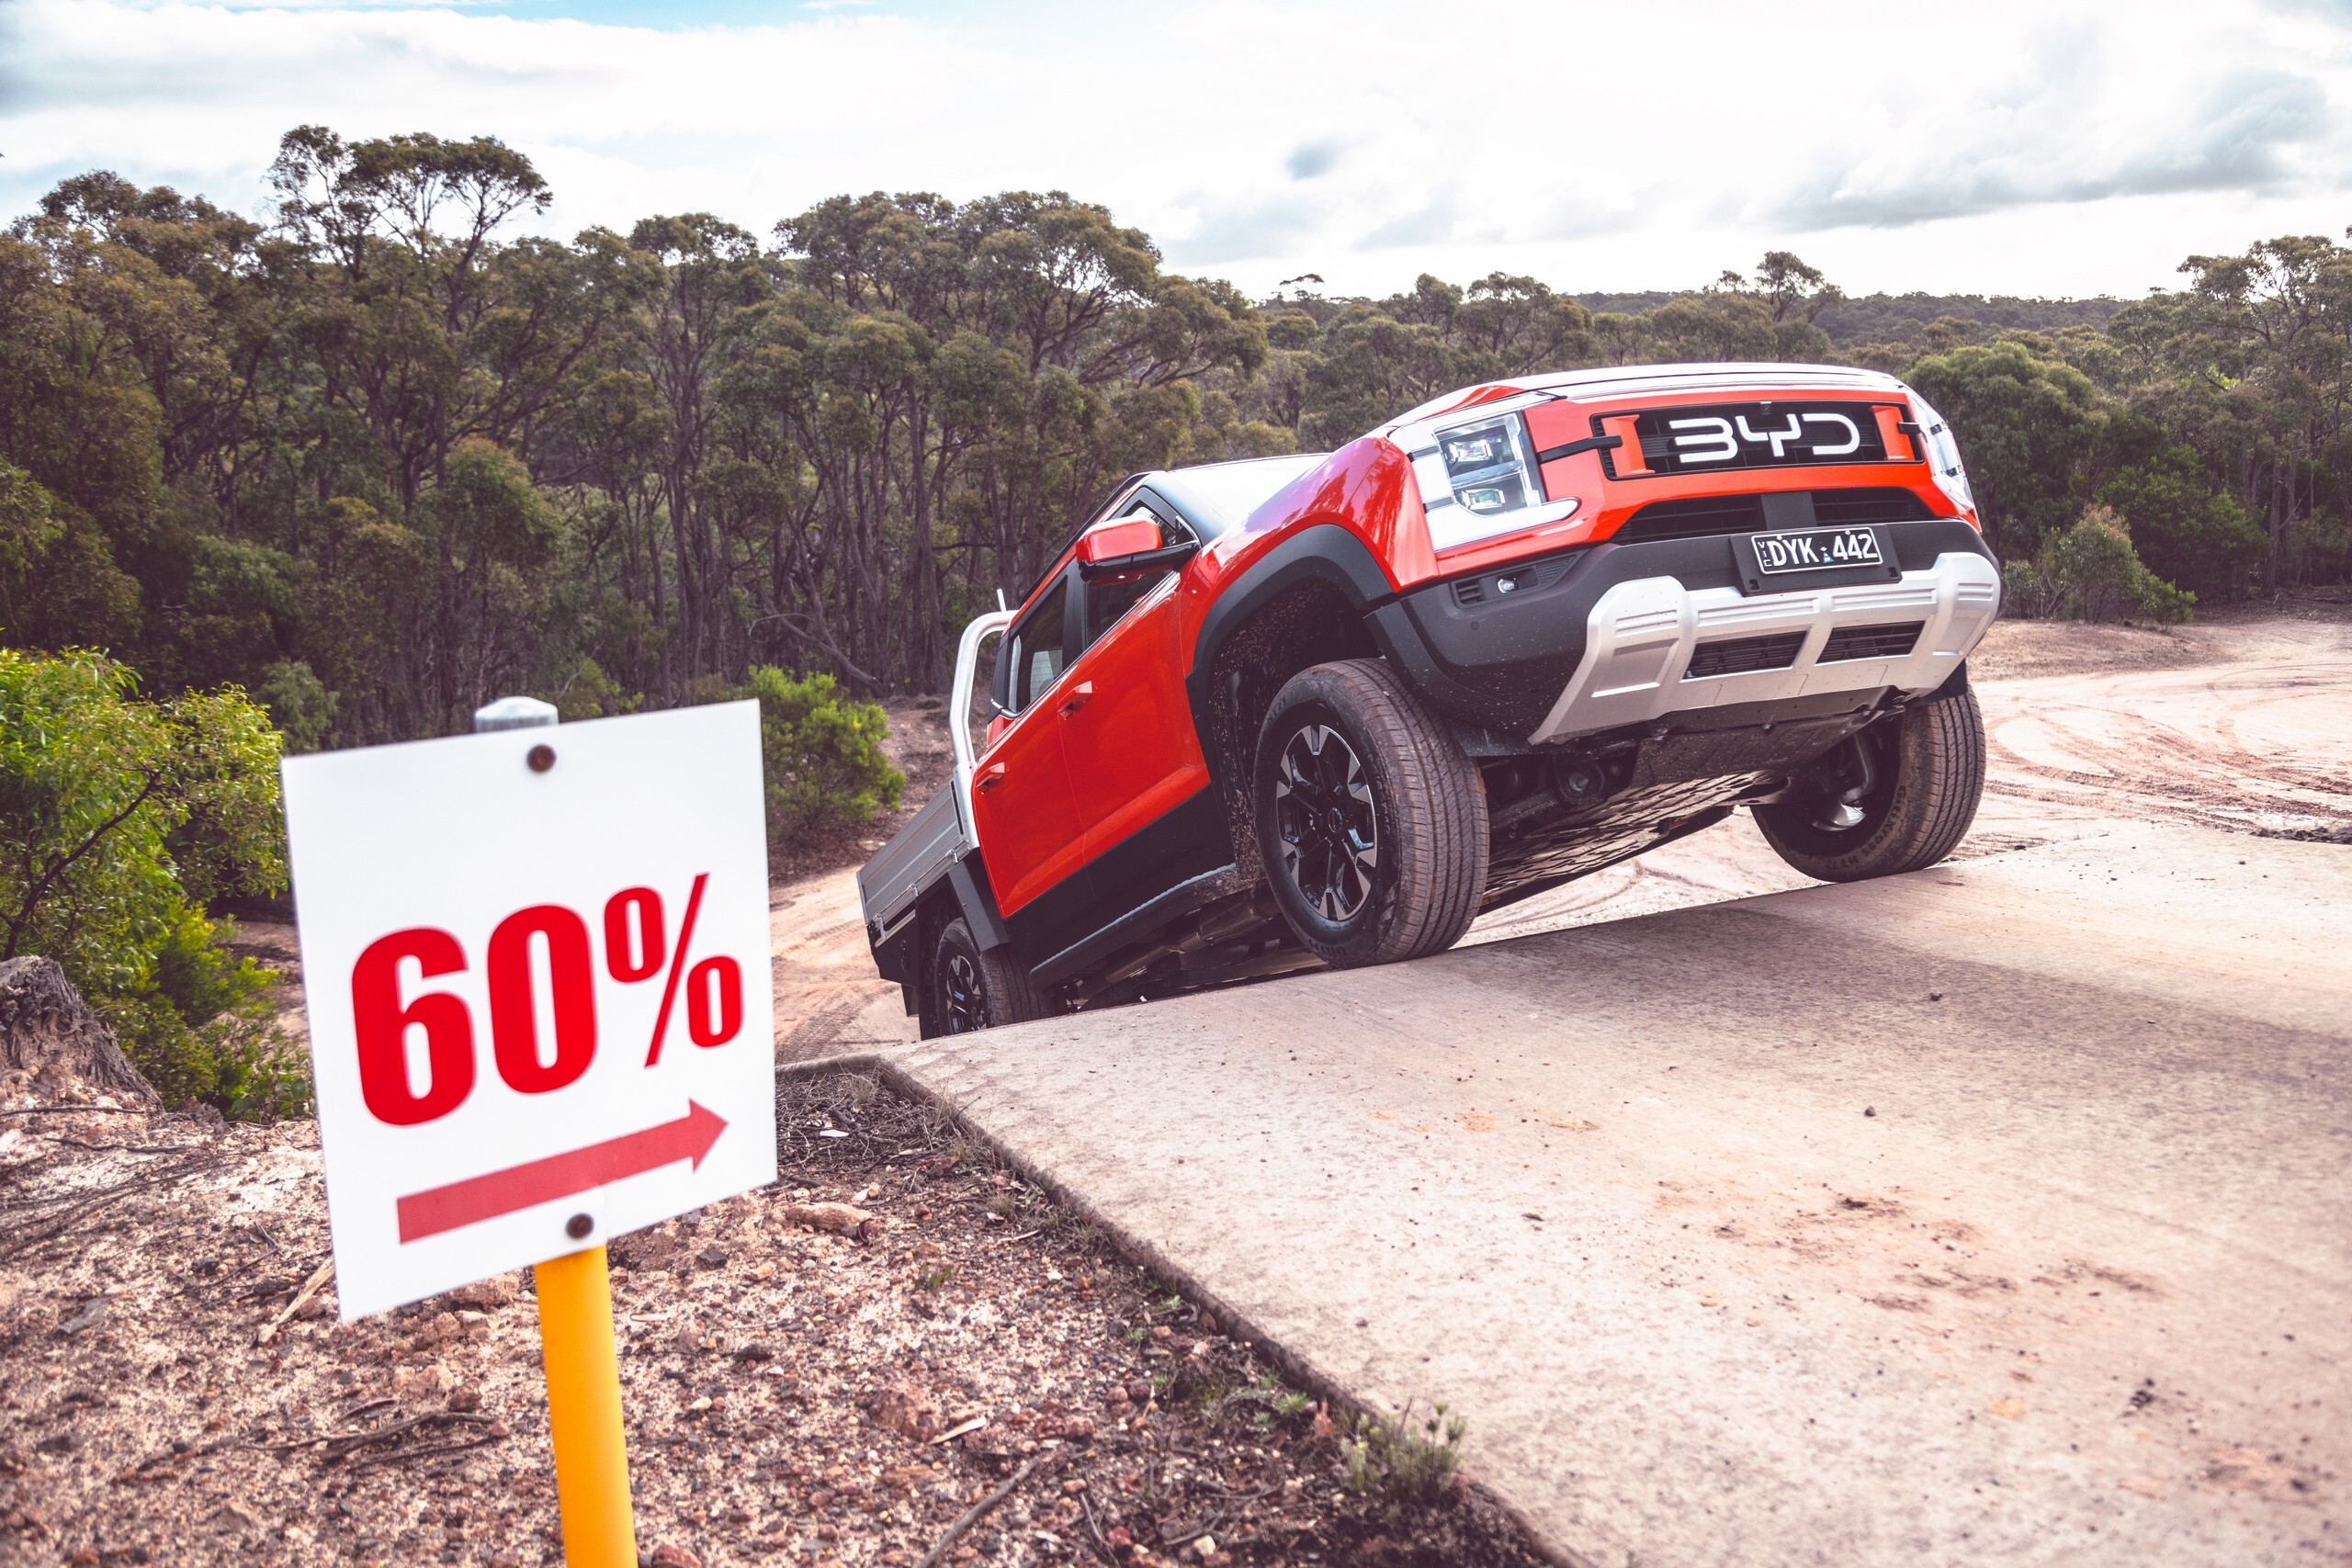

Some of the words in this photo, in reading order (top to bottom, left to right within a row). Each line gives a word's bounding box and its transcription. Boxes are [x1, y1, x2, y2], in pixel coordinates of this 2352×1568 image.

[1668, 413, 1860, 463] BYD
[1757, 541, 1772, 567] VIC
[1766, 537, 1820, 567] DYK
[1833, 534, 1879, 560] 442
[352, 872, 743, 1125] 60%
